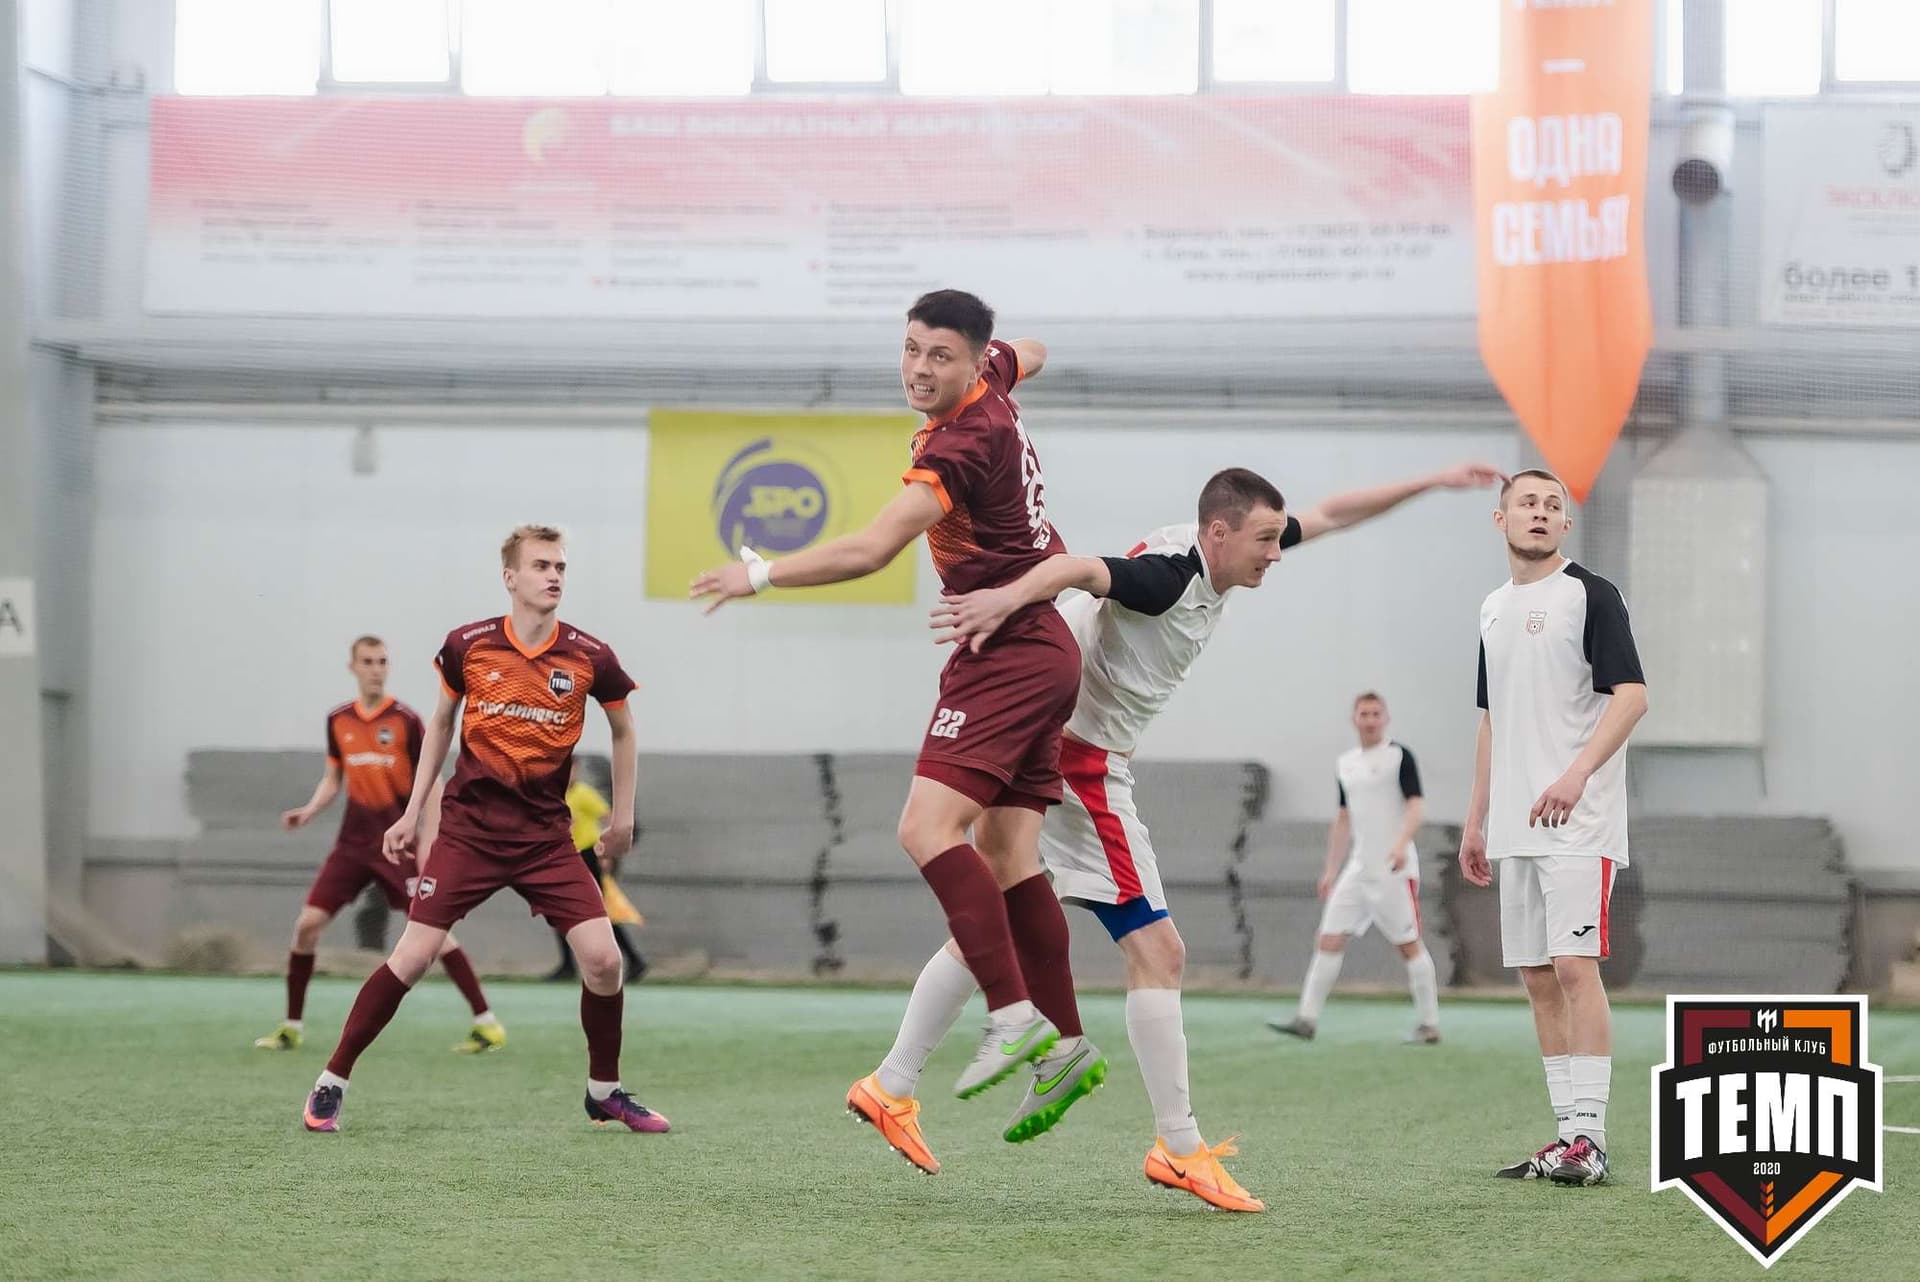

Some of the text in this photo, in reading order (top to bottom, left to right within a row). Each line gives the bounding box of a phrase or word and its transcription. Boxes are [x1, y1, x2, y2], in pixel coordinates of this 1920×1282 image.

[1506, 112, 1624, 189] ОДНА
[1783, 262, 1889, 291] более
[930, 707, 967, 739] 22
